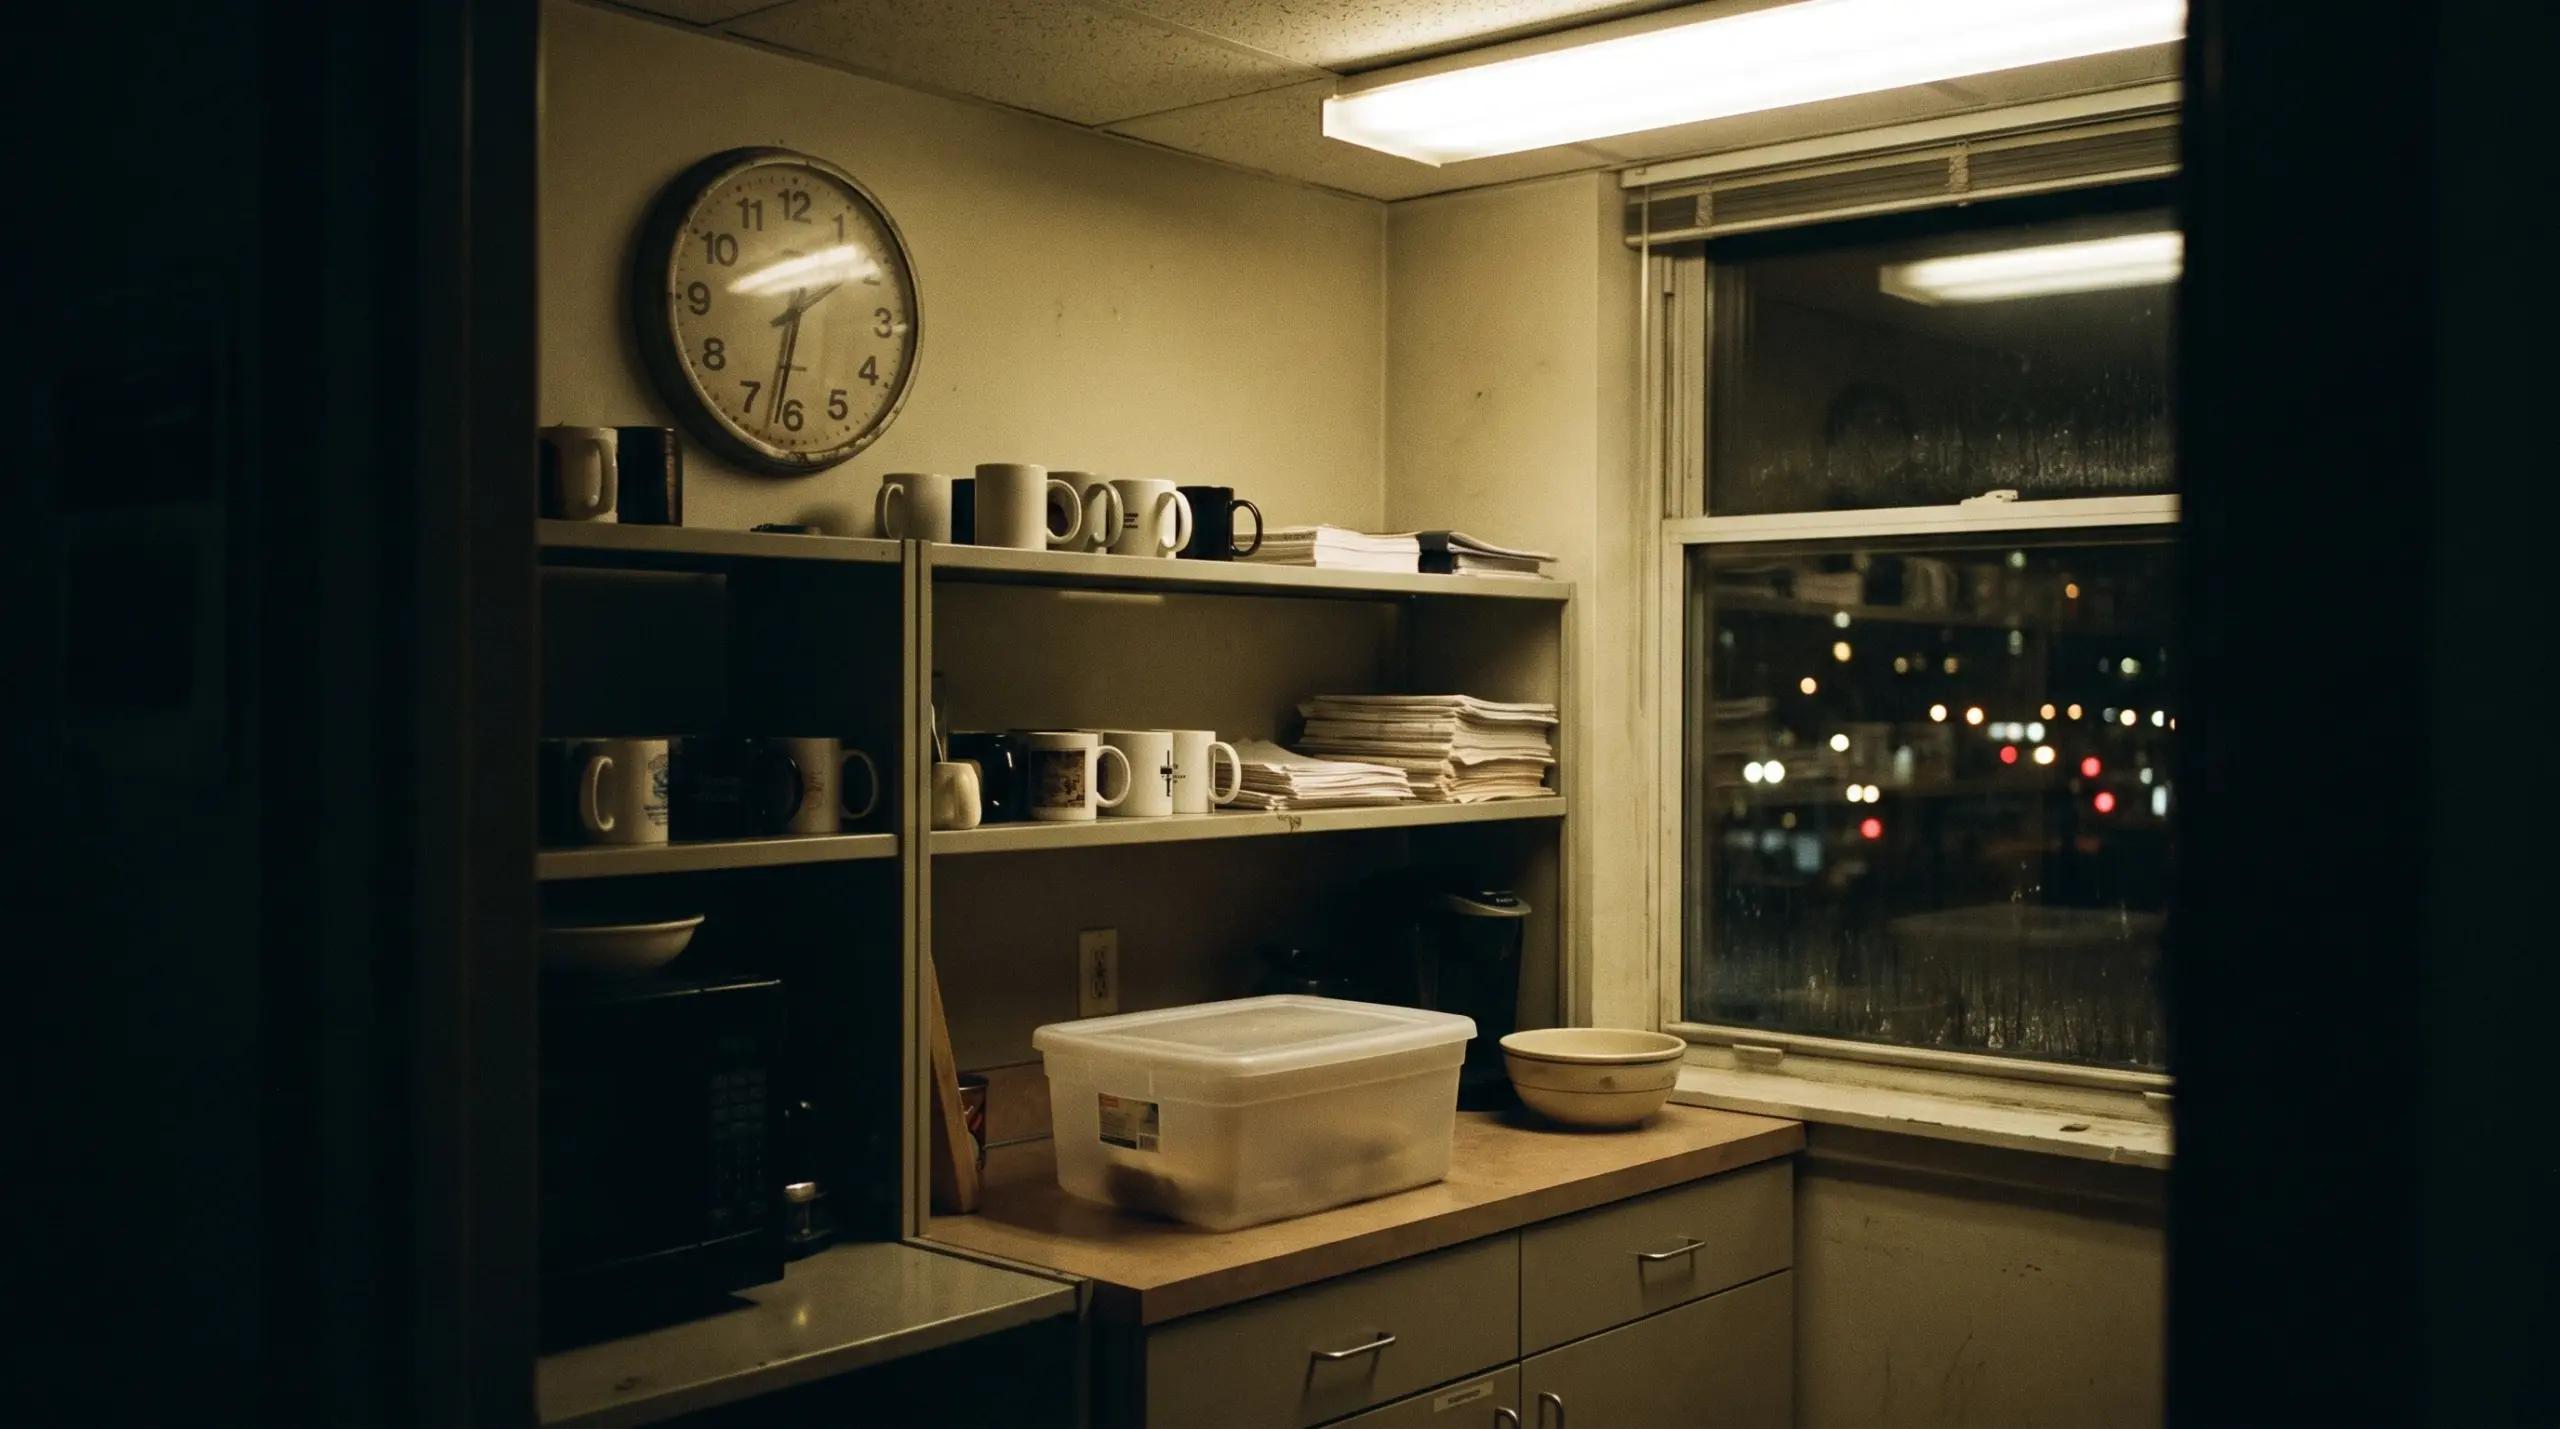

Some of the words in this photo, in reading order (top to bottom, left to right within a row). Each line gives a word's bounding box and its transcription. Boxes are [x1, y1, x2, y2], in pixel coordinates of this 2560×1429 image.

[736, 197, 763, 231] 11
[778, 189, 811, 224] 12
[832, 213, 844, 241] 1
[701, 231, 738, 266] 10
[687, 282, 711, 315] 9
[873, 308, 892, 338] 3
[702, 338, 725, 371] 8
[858, 356, 879, 385] 4
[740, 380, 761, 412] 7
[827, 389, 848, 420] 5
[782, 400, 803, 432] 6
